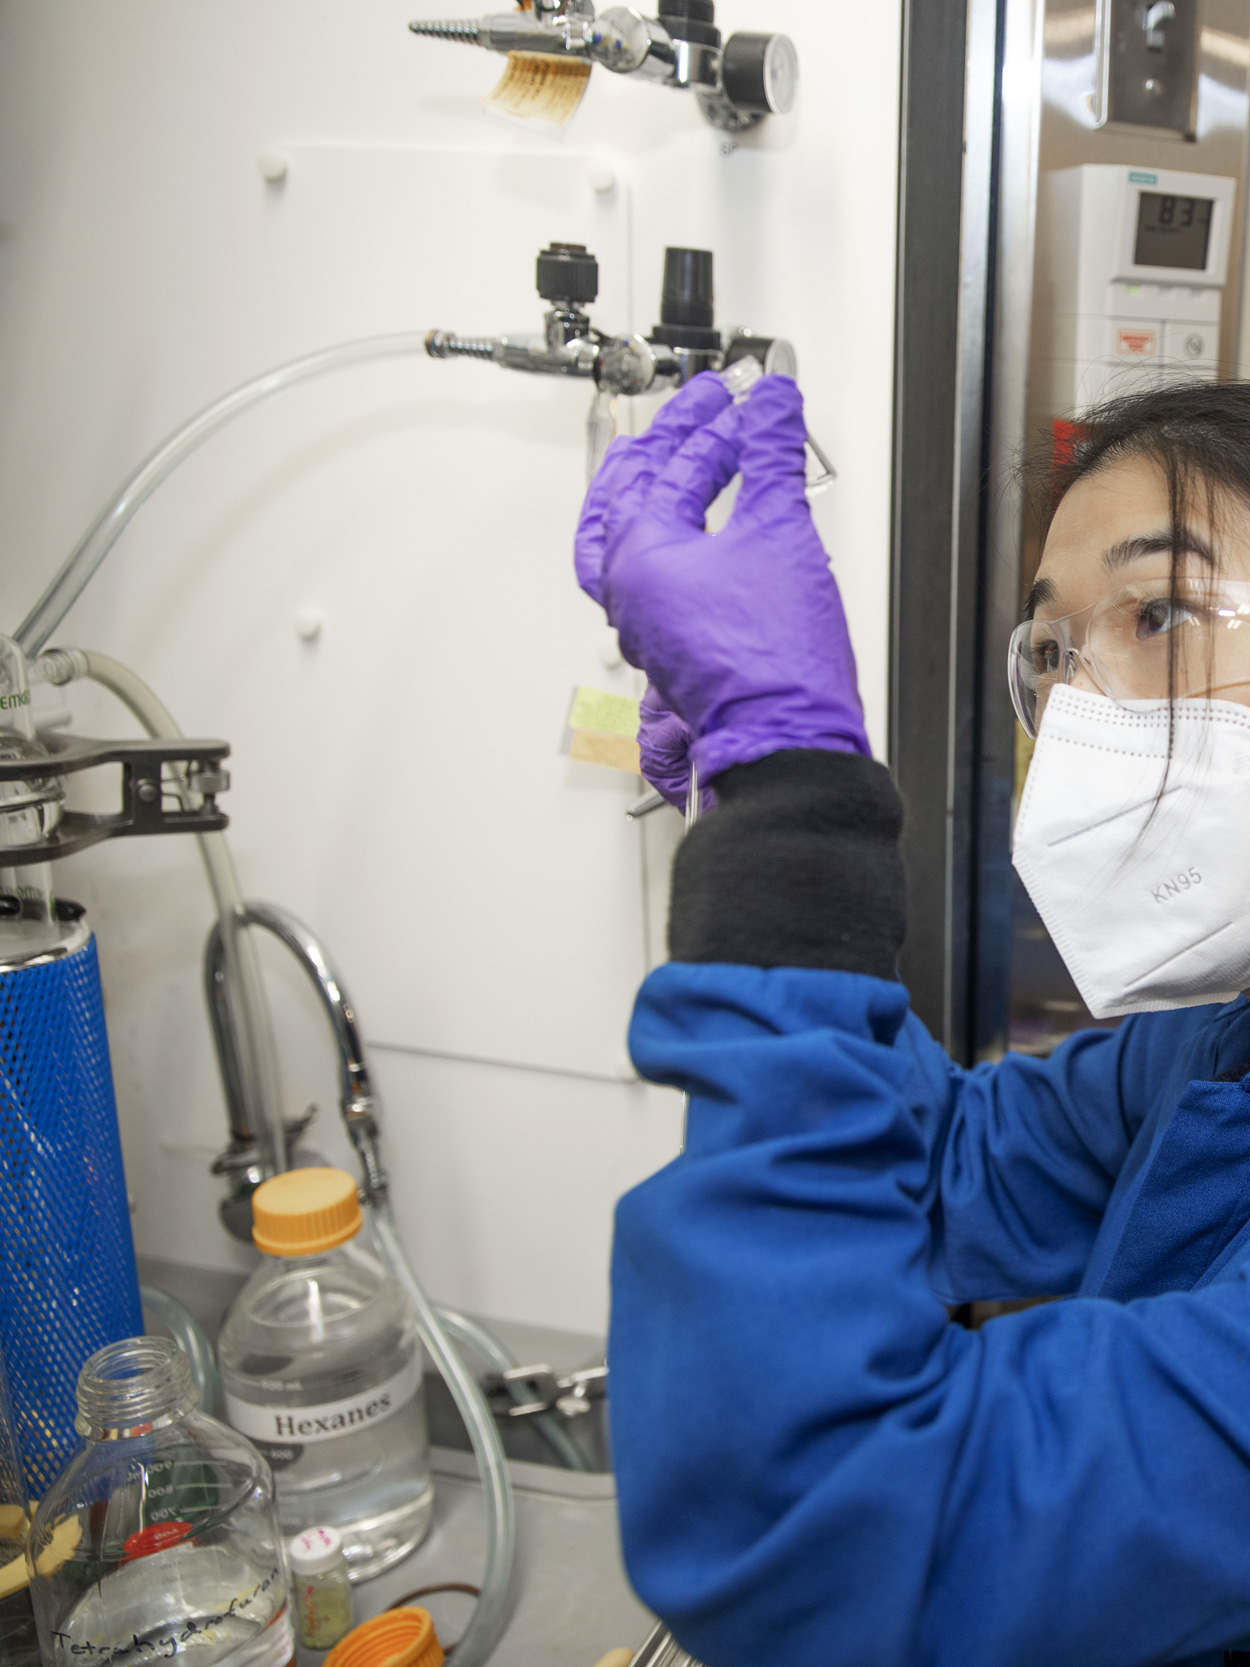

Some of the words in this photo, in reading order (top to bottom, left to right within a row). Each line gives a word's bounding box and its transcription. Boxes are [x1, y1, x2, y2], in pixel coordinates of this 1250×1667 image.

[1150, 867, 1202, 904] KN95
[274, 1393, 392, 1437] Hexanes
[52, 1567, 278, 1658] Tetrahydrofuran
